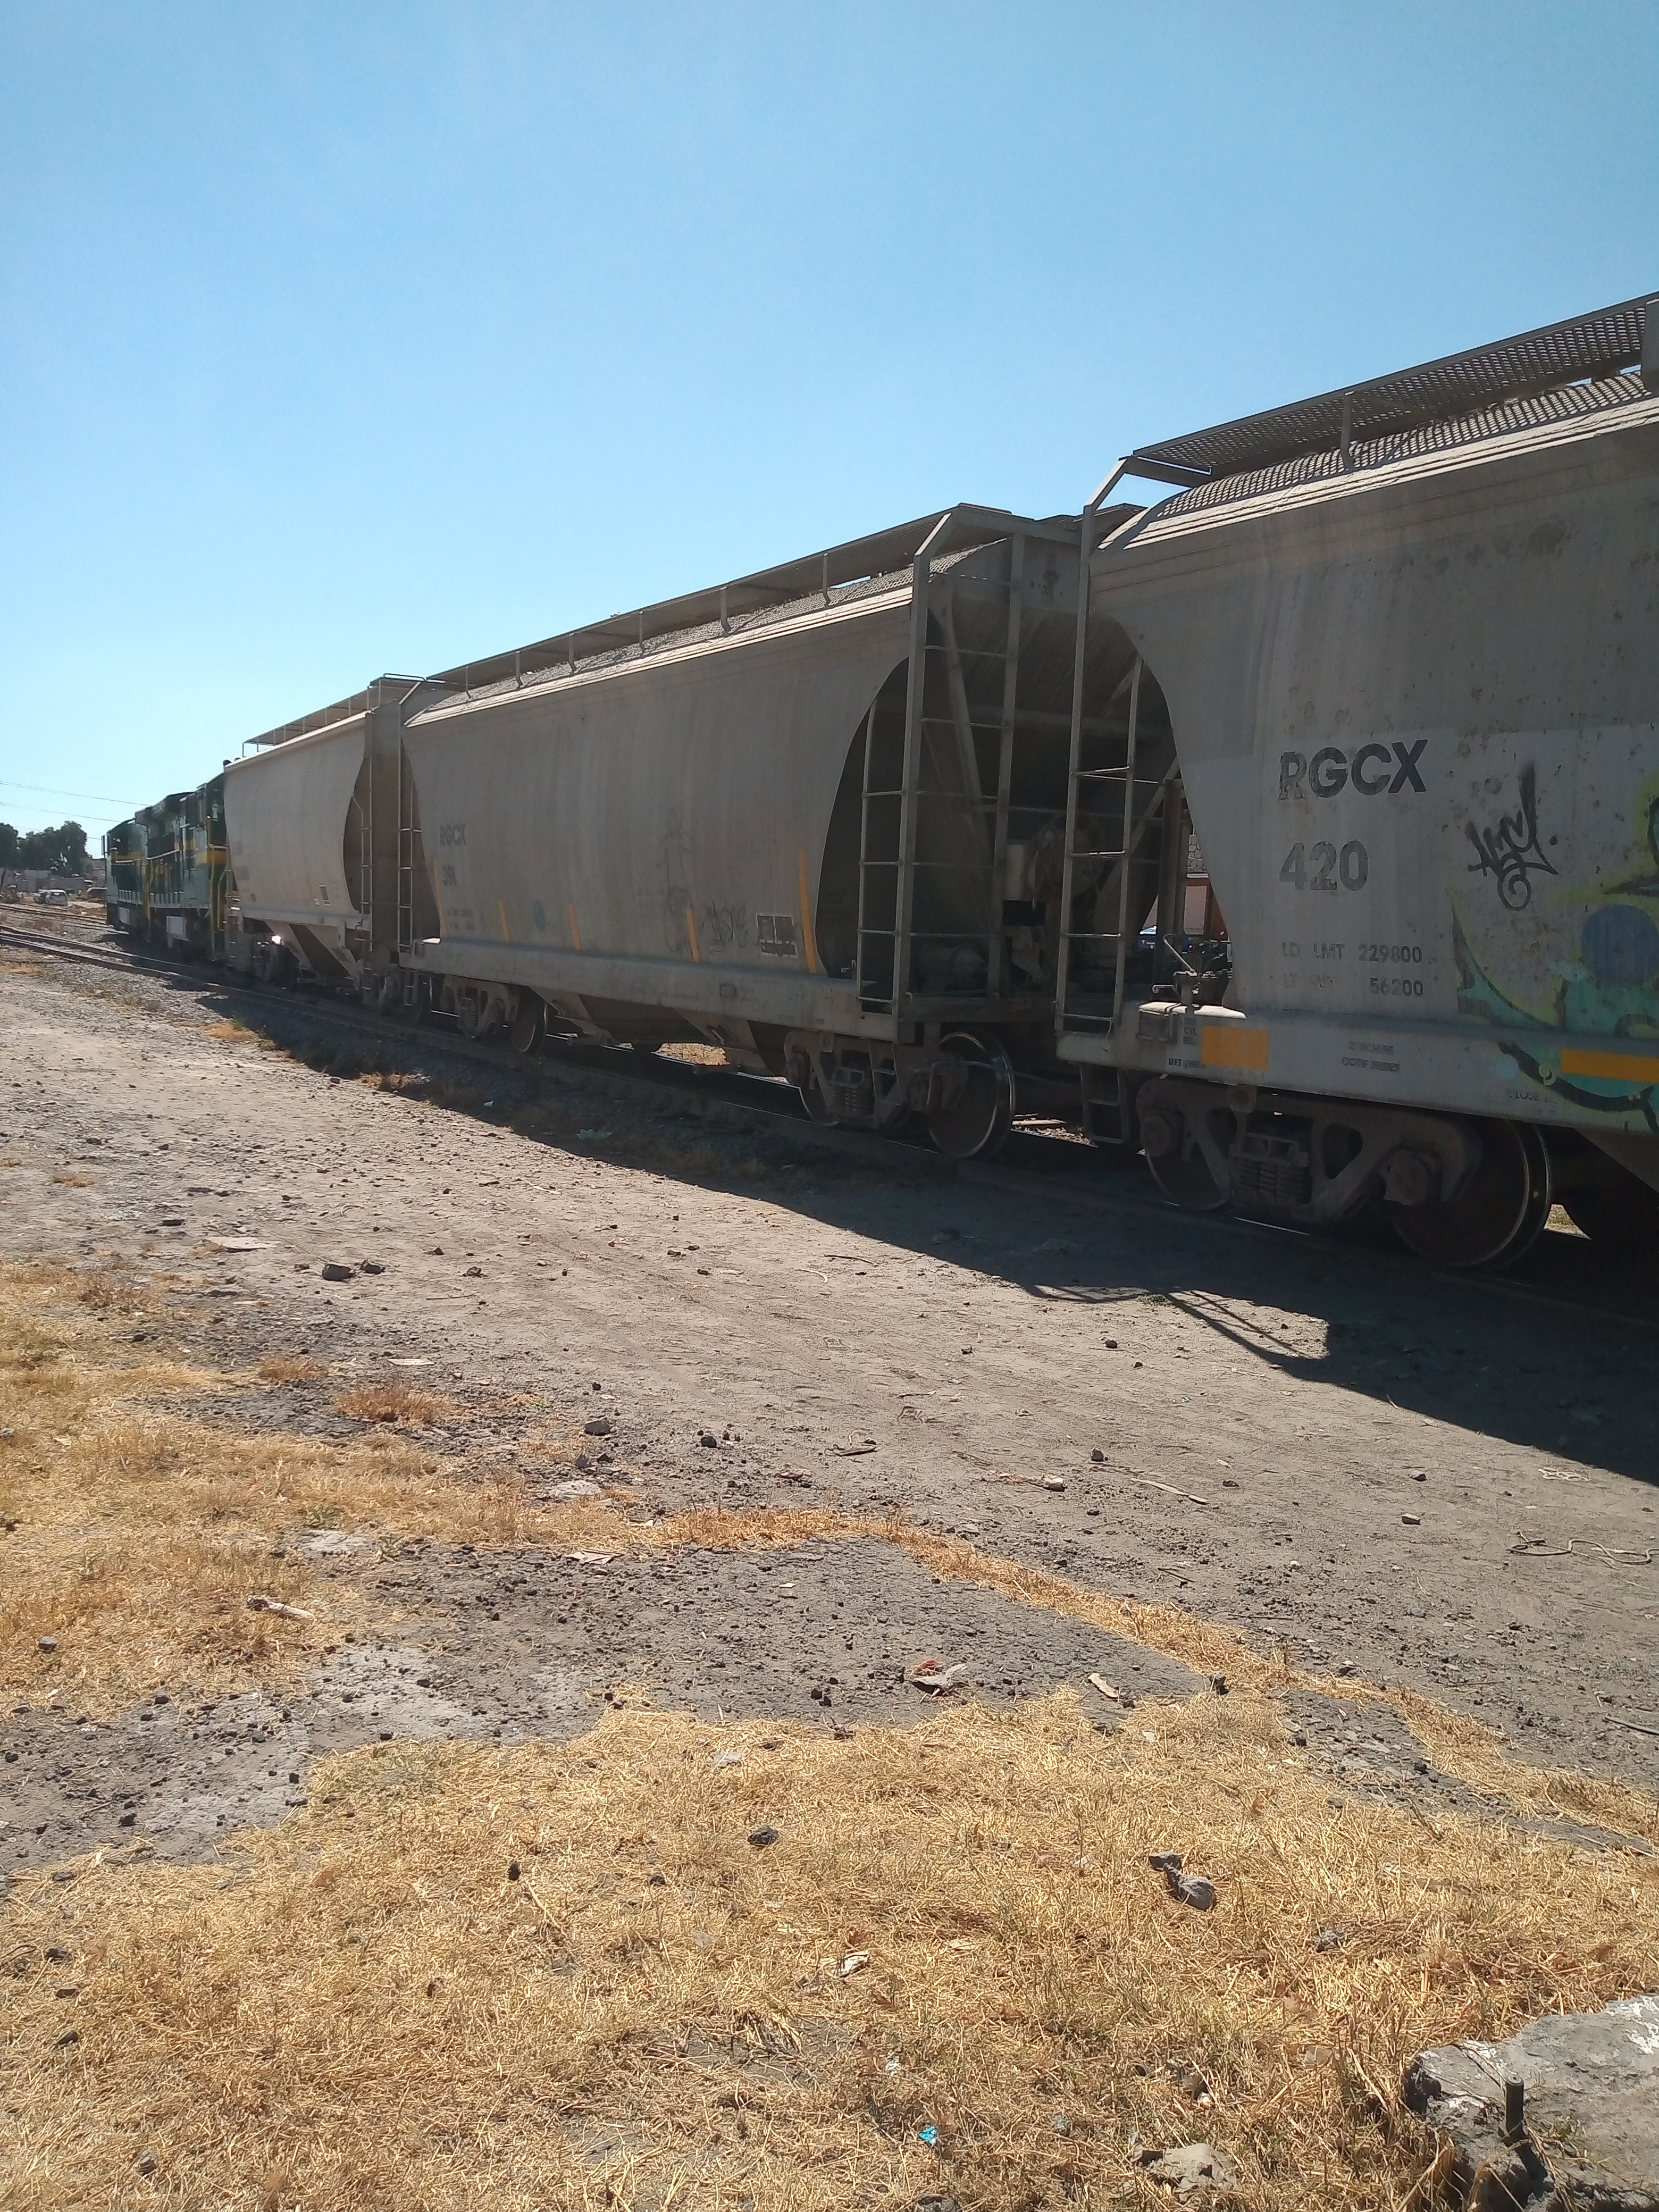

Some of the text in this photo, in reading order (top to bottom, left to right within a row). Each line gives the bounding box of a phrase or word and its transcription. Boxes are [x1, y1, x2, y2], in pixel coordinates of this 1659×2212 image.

[1278, 739, 1429, 800] RGCX
[439, 822, 466, 847] RGCX
[1279, 839, 1369, 891] 420
[1359, 944, 1422, 963] 229800
[1370, 977, 1423, 997] 56200
[1168, 1058, 1182, 1067] LIFT
